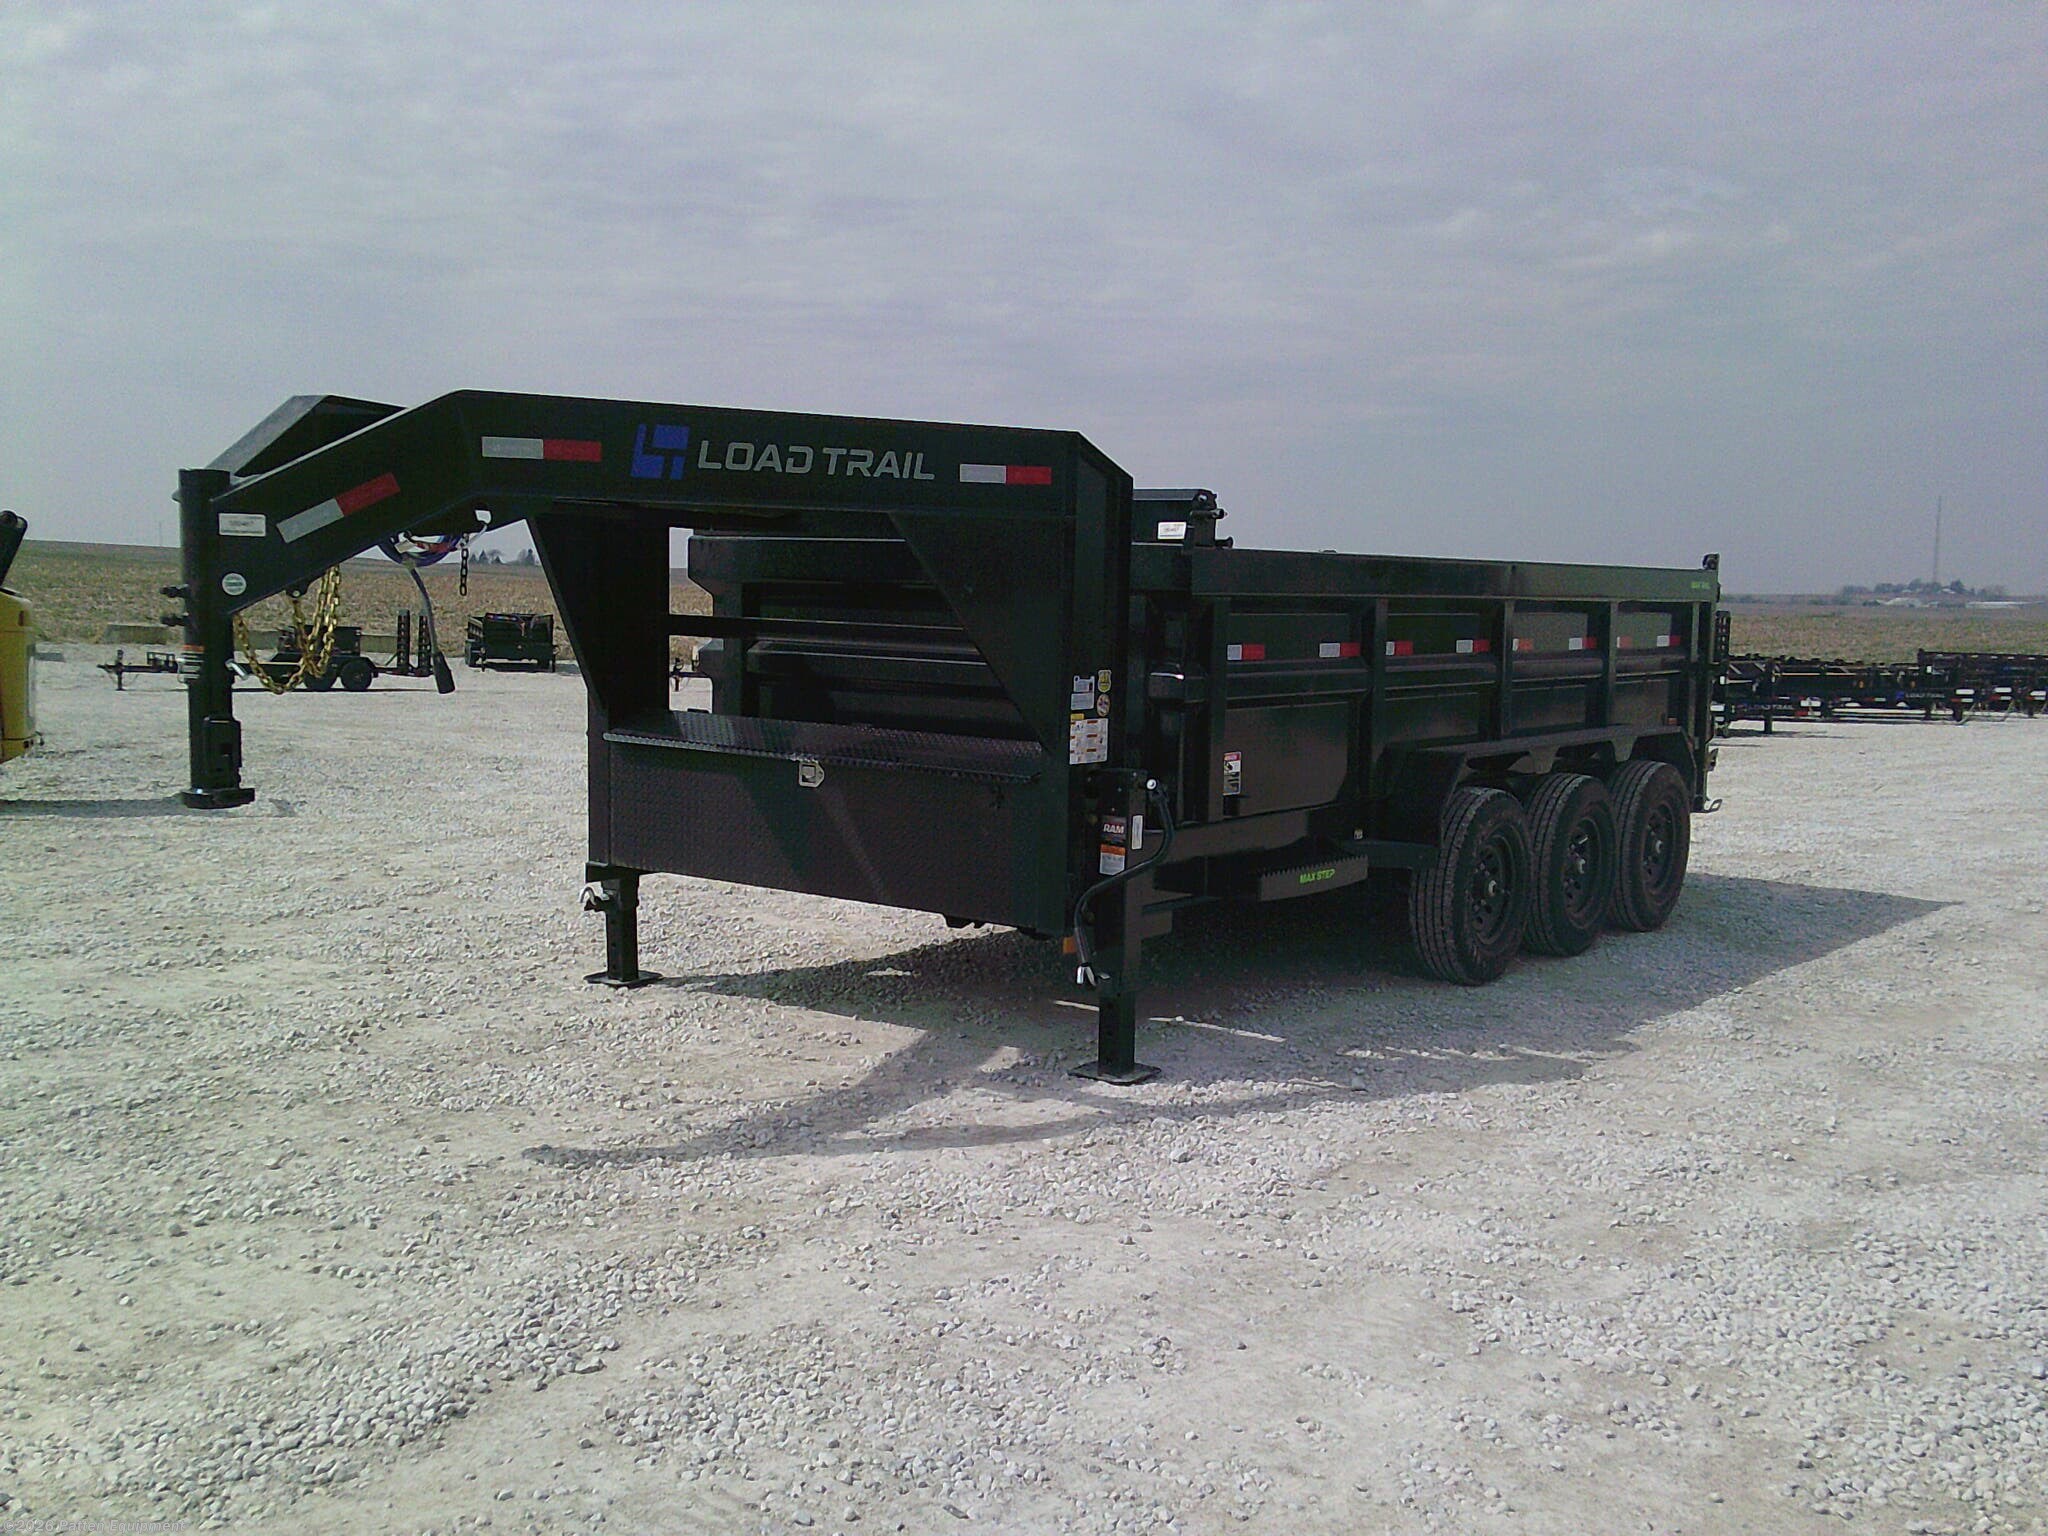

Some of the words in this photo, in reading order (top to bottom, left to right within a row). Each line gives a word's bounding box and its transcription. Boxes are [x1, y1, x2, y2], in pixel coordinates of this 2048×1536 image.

[698, 440, 814, 474] LOAD
[823, 447, 936, 481] TRAIL
[1103, 823, 1125, 834] RAM
[1299, 872, 1316, 884] MAX
[1317, 868, 1336, 881] STEP
